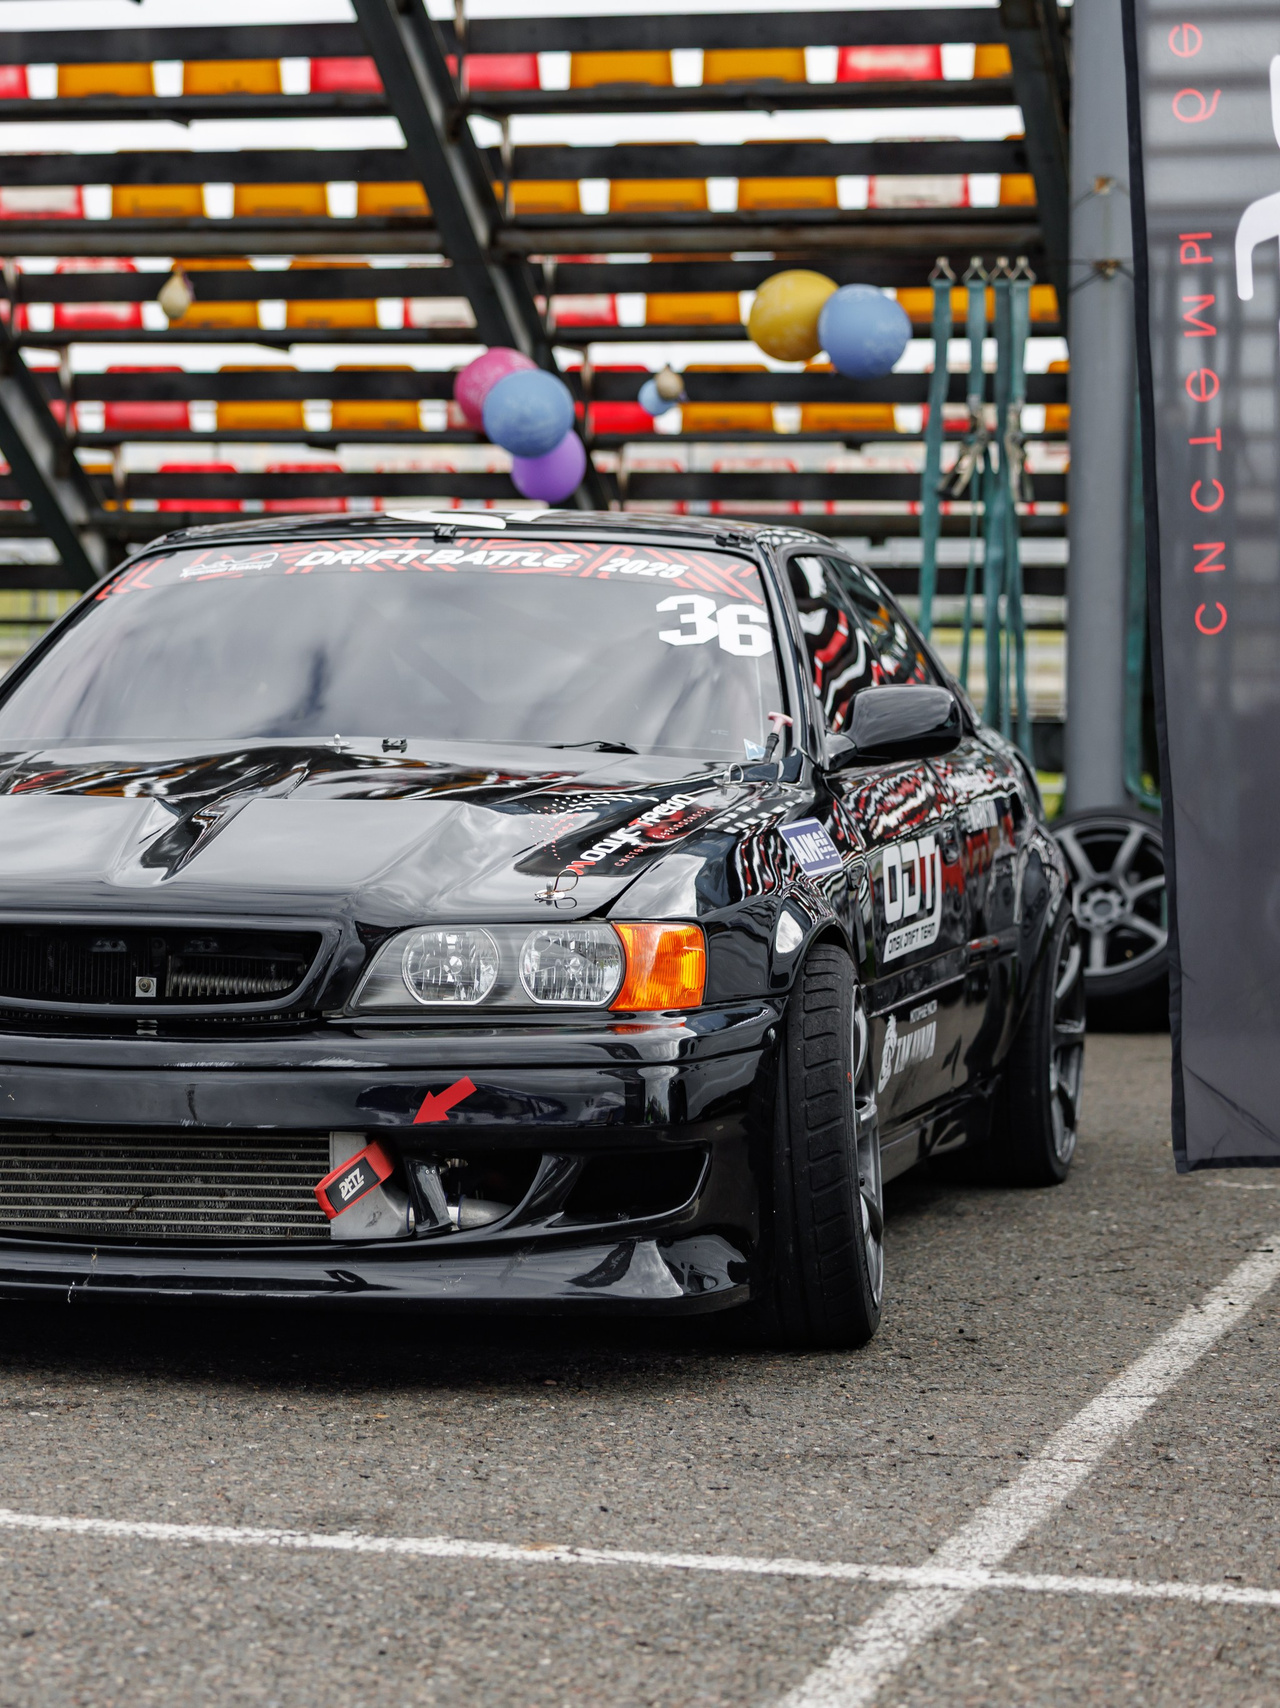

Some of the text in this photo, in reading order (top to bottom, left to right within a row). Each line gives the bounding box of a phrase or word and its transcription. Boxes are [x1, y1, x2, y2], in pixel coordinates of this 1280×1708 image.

[294, 549, 691, 579] DRIFT BATTLE 2025
[656, 593, 773, 657] 36
[883, 834, 936, 925] ODT
